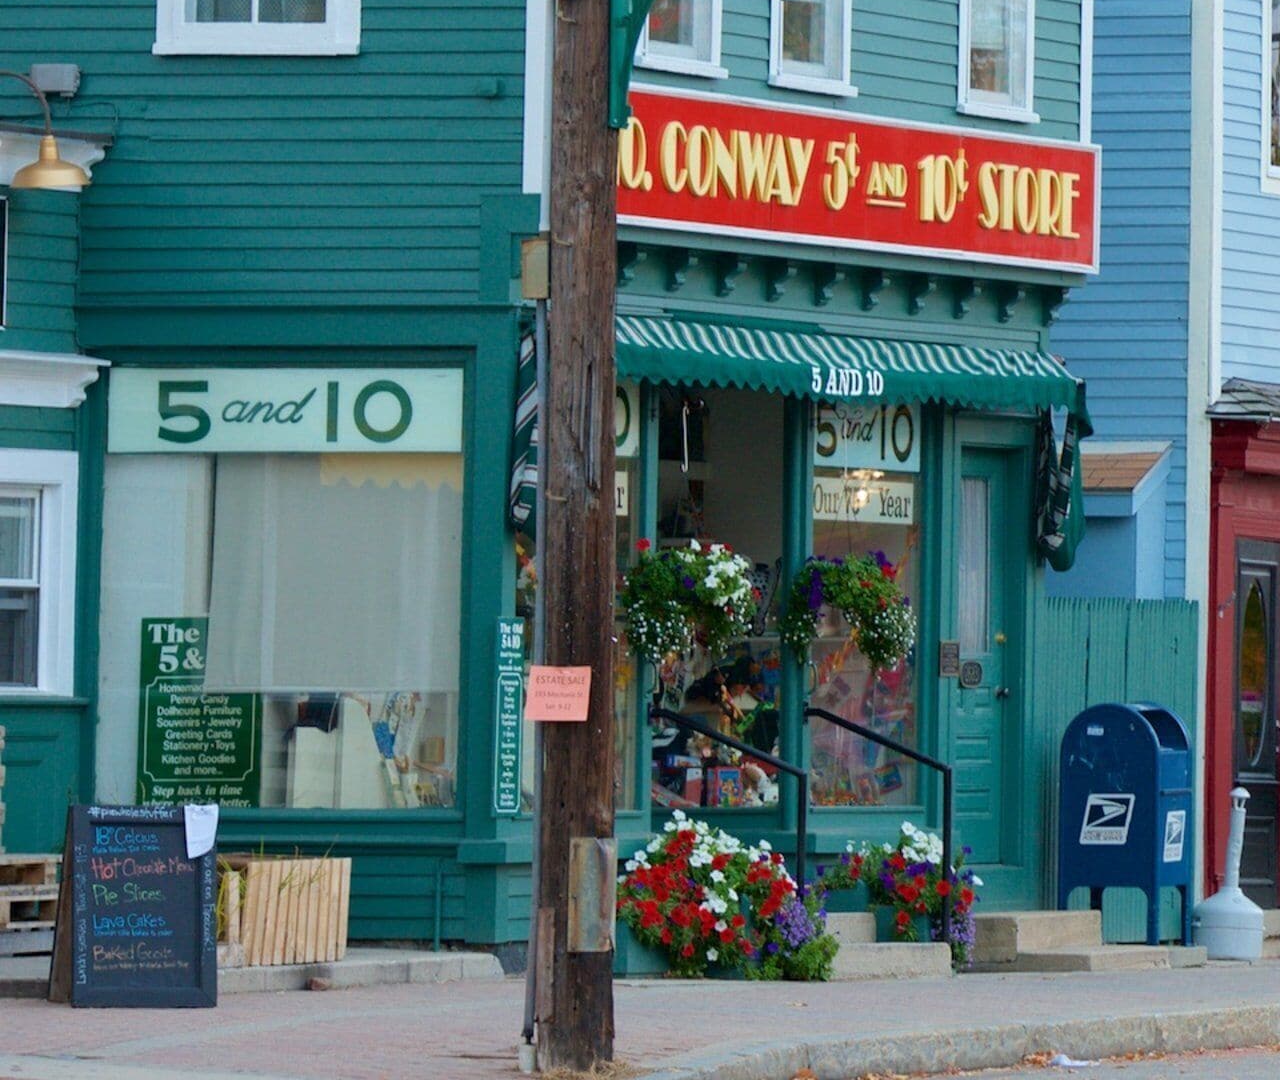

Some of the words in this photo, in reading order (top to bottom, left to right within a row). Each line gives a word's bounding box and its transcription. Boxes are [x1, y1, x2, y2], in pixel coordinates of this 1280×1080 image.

[616, 117, 652, 191] O.
[661, 120, 815, 206] CONWAY
[866, 161, 908, 199] AND
[977, 161, 1081, 240] STORE
[812, 367, 822, 393] 5
[825, 368, 863, 396] AND
[866, 370, 884, 396] 10
[158, 380, 211, 443] 5
[221, 387, 317, 423] and
[326, 379, 413, 443] 10
[816, 401, 838, 457] 5
[880, 402, 914, 463] 10
[813, 483, 839, 514] Our
[879, 487, 911, 518] Year
[148, 623, 200, 644] The
[158, 645, 179, 672] 5
[182, 647, 205, 670] &
[157, 706, 201, 716] Dollhouse
[203, 705, 243, 716] Furniture
[170, 695, 198, 705] Penny
[200, 695, 229, 705] Candy
[156, 718, 201, 728] Souvenirs
[207, 717, 242, 728] Jewelry
[163, 740, 209, 751] Stationery
[215, 740, 236, 751] Toys
[165, 729, 203, 741] Greeting
[206, 729, 233, 739] Cards
[161, 754, 196, 764] Kitchen
[198, 754, 236, 763] Goodies
[174, 765, 191, 775] and
[152, 784, 174, 798] Step
[177, 784, 201, 796] back
[205, 784, 216, 796] in
[219, 784, 243, 796] time
[91, 857, 122, 879] Hot
[93, 883, 118, 905] Pie
